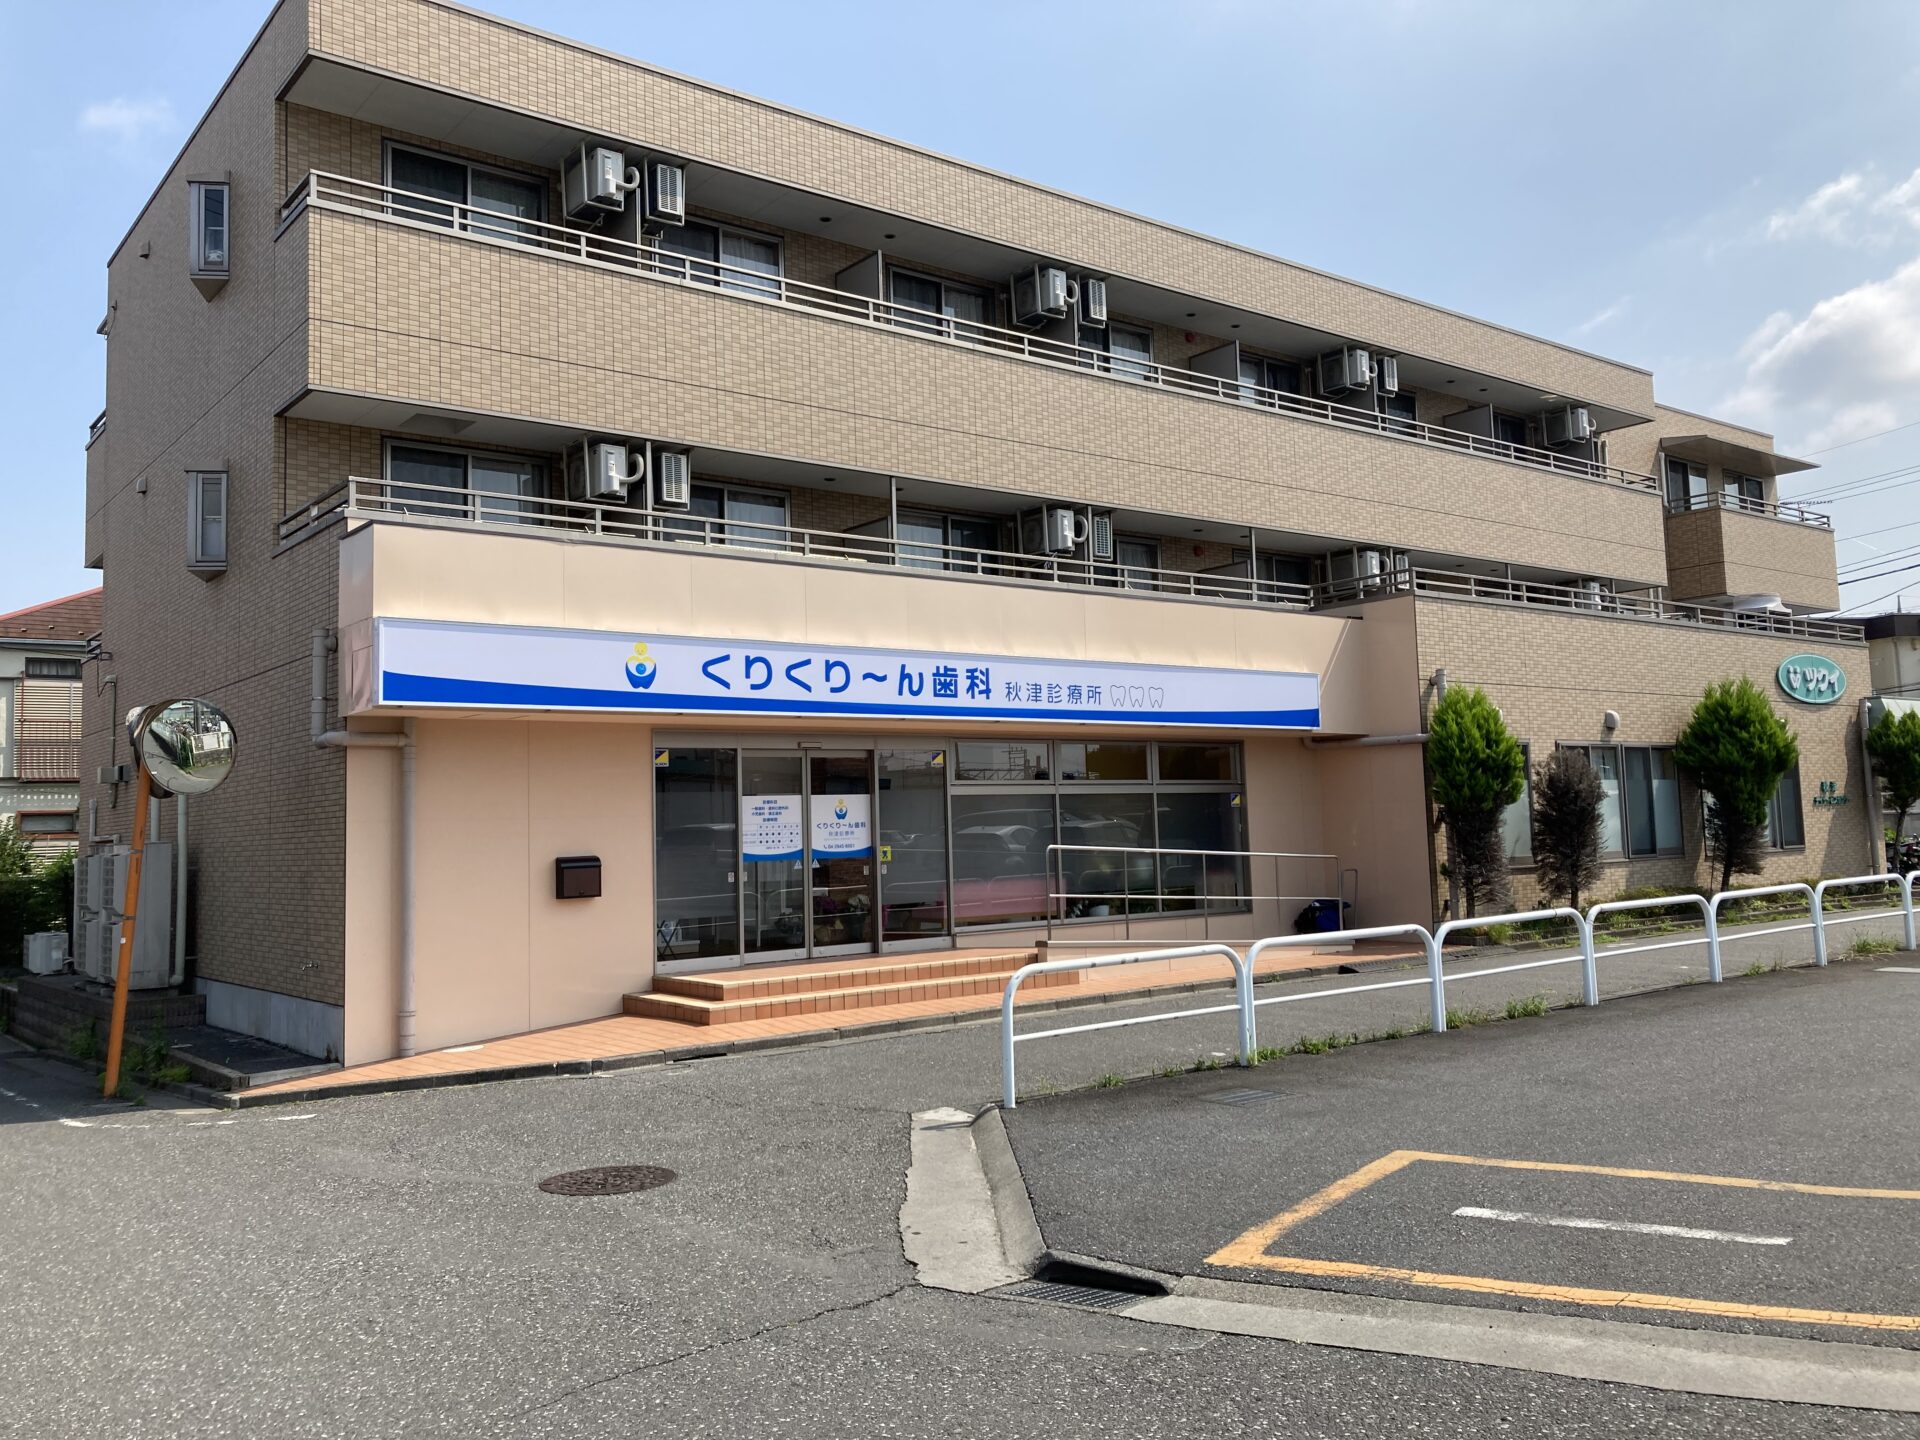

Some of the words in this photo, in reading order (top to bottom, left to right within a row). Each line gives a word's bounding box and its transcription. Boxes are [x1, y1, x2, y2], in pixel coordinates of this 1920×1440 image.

[1801, 667, 1840, 692] ツクイ
[1005, 681, 1102, 706] 秋津診療所
